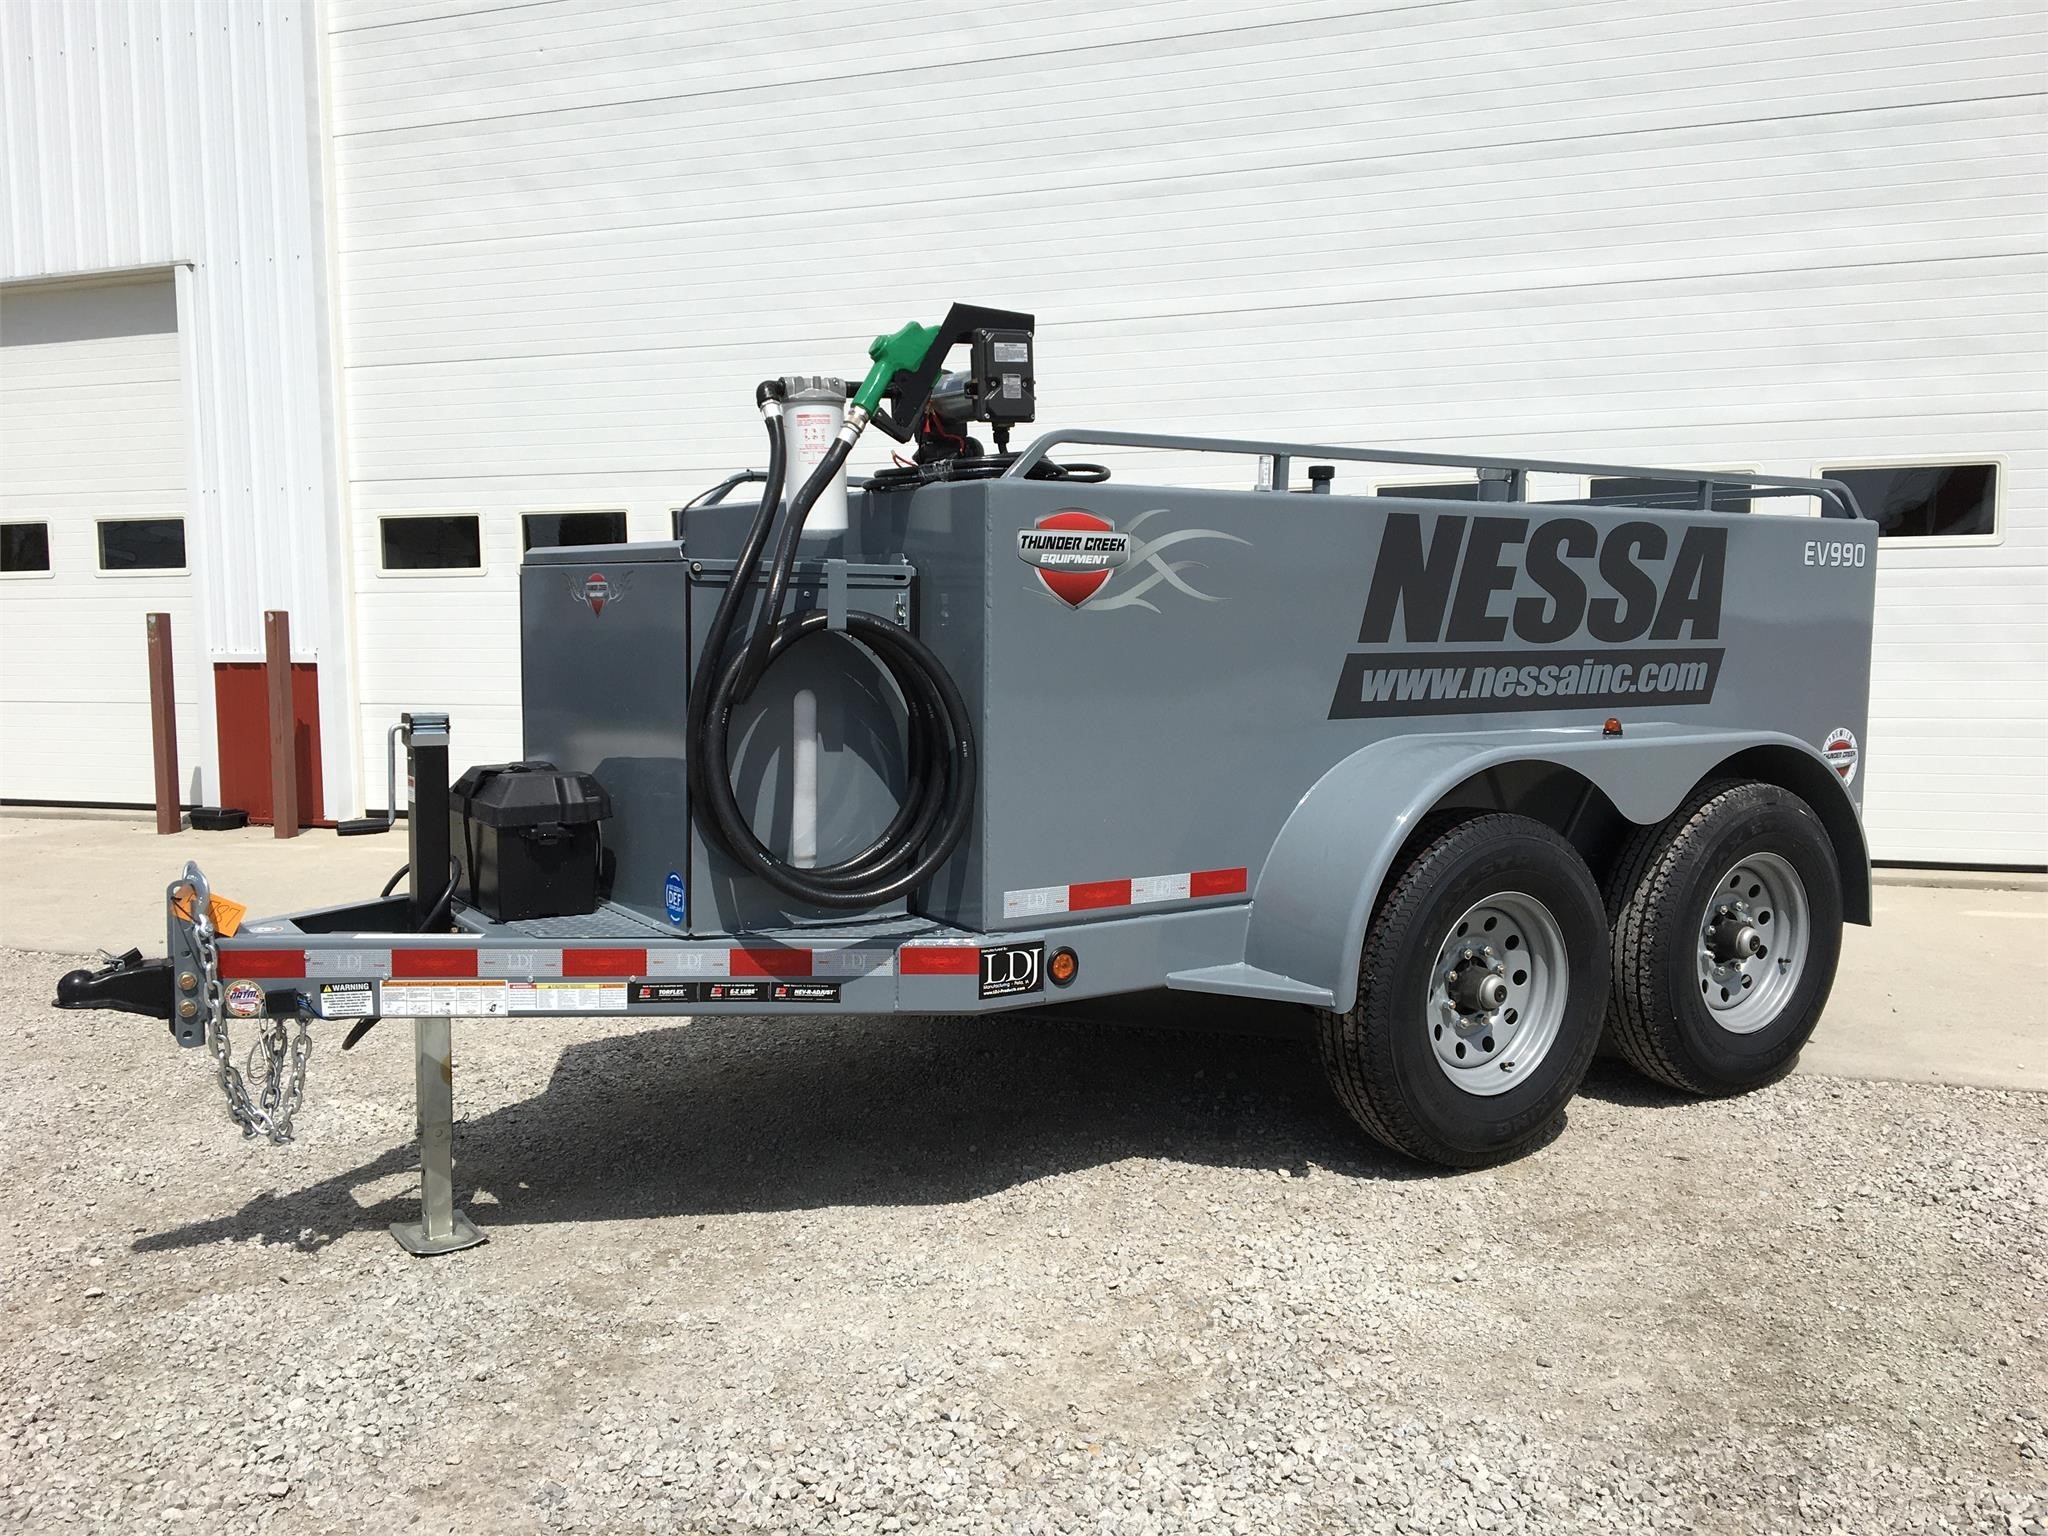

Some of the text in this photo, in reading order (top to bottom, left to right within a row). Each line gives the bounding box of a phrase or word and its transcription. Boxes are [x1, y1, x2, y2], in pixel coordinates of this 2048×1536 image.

[1021, 535, 1126, 552] THUNDER CREEK
[1804, 541, 1866, 567] EV990
[1040, 553, 1109, 565] EQUIPMENT
[1357, 512, 1728, 644] NESSA
[1361, 658, 1708, 702] www.nessainc.com
[669, 890, 682, 907] DEF
[984, 948, 1043, 989] LDJ
[332, 983, 369, 991] WARNING
